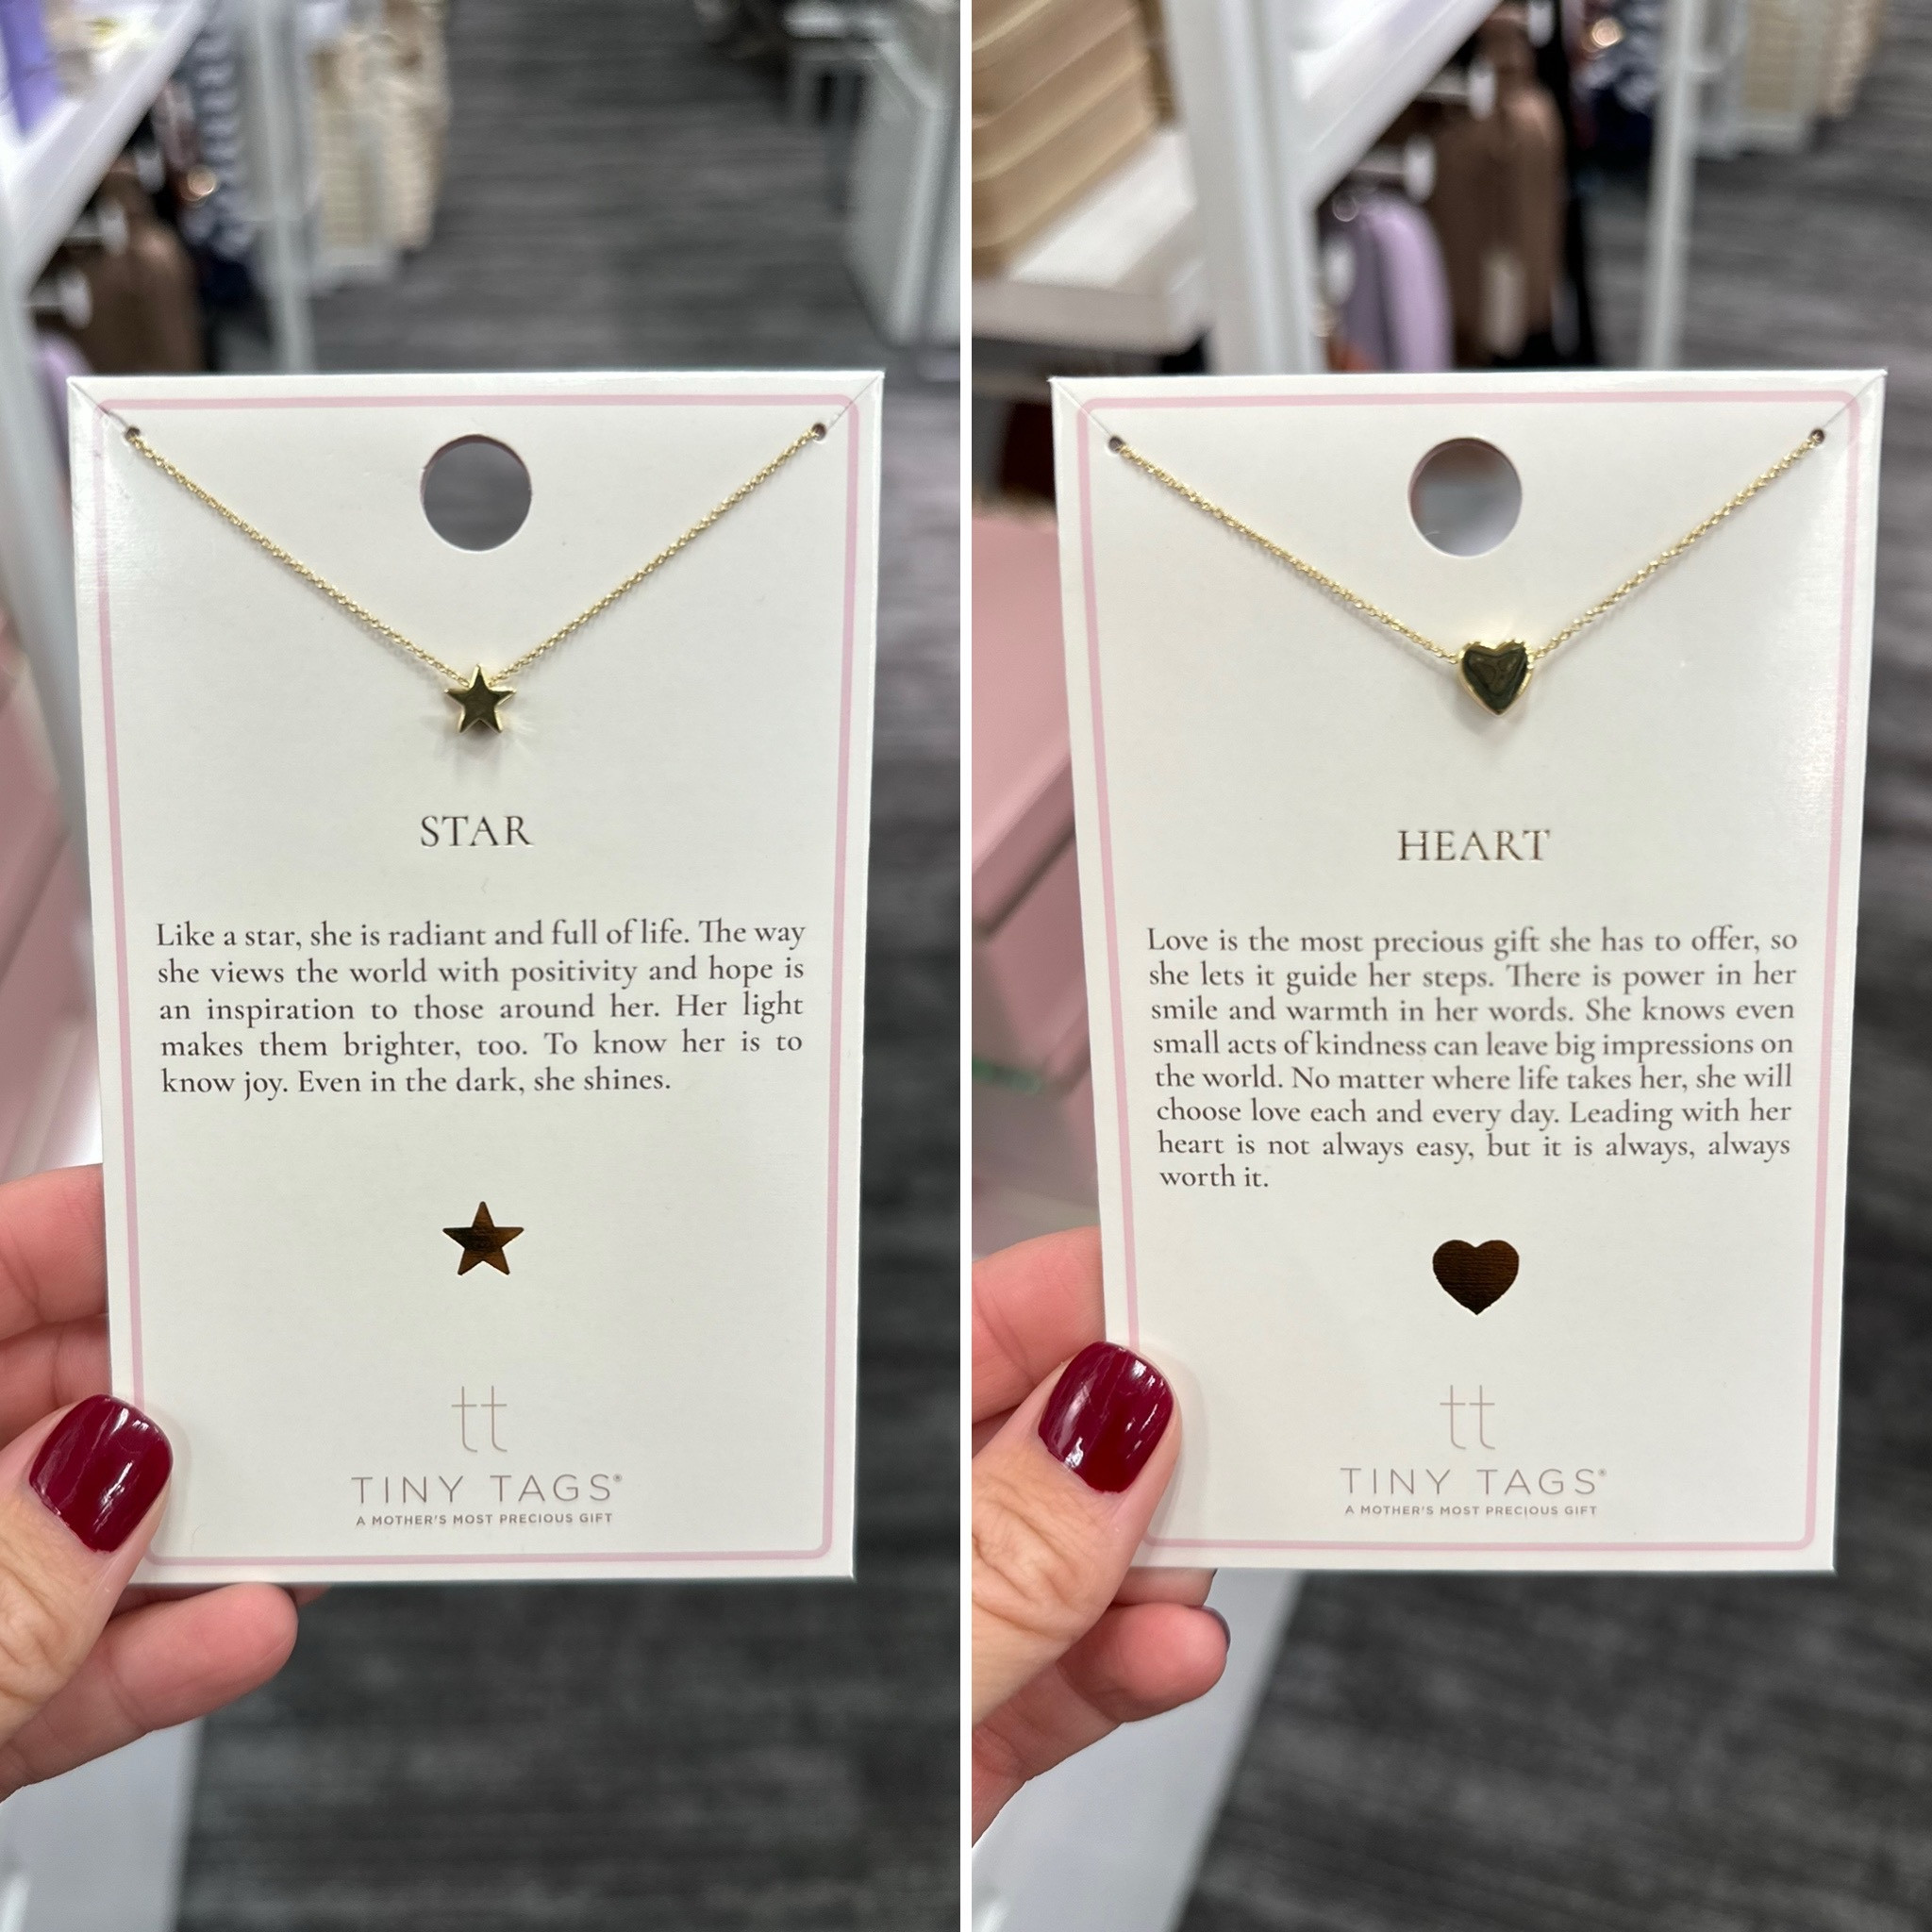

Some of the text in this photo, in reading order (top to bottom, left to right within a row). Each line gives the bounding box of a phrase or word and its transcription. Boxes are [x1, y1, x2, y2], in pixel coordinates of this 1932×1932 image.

[420, 814, 532, 848] STAR
[1397, 828, 1551, 861] HEART
[156, 917, 807, 951] Like a star, she is radiant and full of life. The way
[1147, 924, 1798, 962] Love is the most precious gift she has to offer, so
[158, 954, 805, 991] she views the world with positivity and hope is
[1149, 958, 1797, 996] she lets it guide her steps. There is power in her
[159, 989, 804, 1029] an inspiration to those around her. Her light
[1151, 994, 1795, 1023] smile and warmth in her words. She knows even
[159, 1026, 803, 1066] makes them brighter, too. To know her is to
[1153, 1028, 1793, 1065] small acts of kindness can leave big impressions on
[160, 1064, 671, 1102] know joy. Even in the dark, she shines.
[1155, 1061, 1792, 1092] the world. No matter where life takes her, she will
[1156, 1095, 1792, 1132] choose love each and every day. Leading with her
[1157, 1128, 1790, 1166] heart is not always easy, but it is always, always
[1158, 1162, 1269, 1188] worth it.
[350, 1474, 464, 1507] TINY
[1340, 1467, 1451, 1496] TINY
[356, 1512, 613, 1527] A MOTHER'S MOST PRECIOUS GIFT
[1344, 1505, 1597, 1518] A MOTHER'S MOST PRECIOUS GIFT
